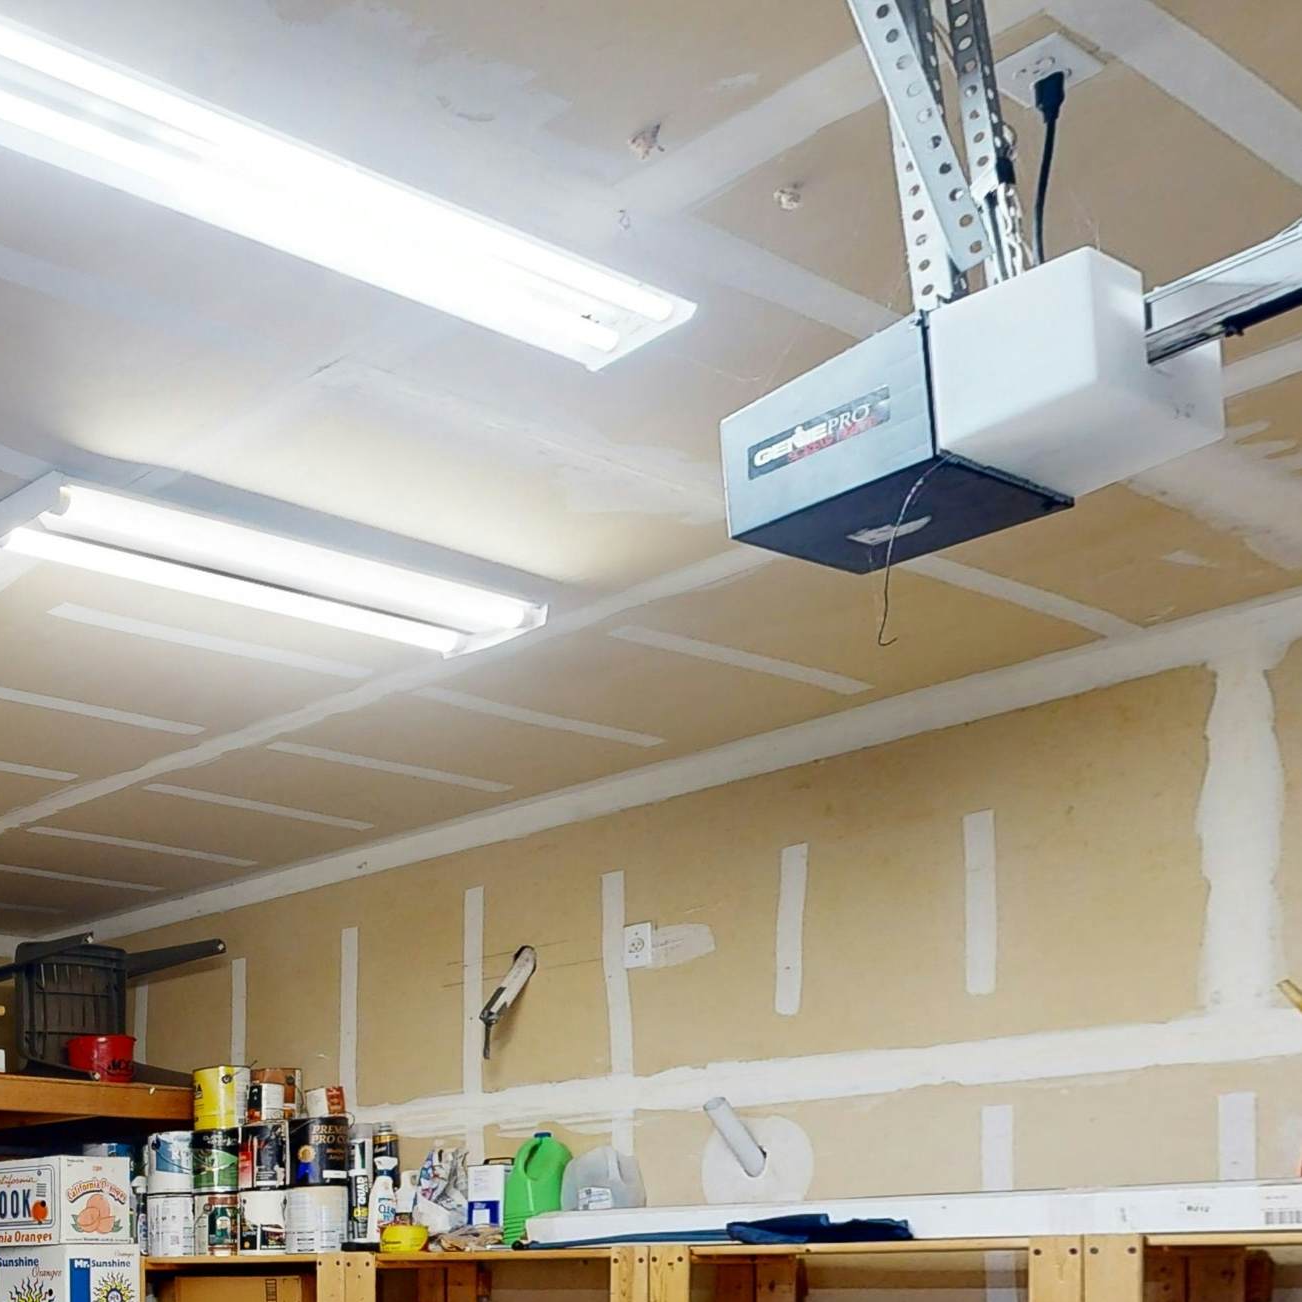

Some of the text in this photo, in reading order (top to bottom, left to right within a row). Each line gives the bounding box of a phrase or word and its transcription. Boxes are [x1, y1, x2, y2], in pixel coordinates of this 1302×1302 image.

[67, 1179, 100, 1200] California
[14, 1230, 53, 1243] Oranges
[73, 1258, 132, 1269] Mr. Sunshine
[30, 1267, 62, 1281] Oranges
